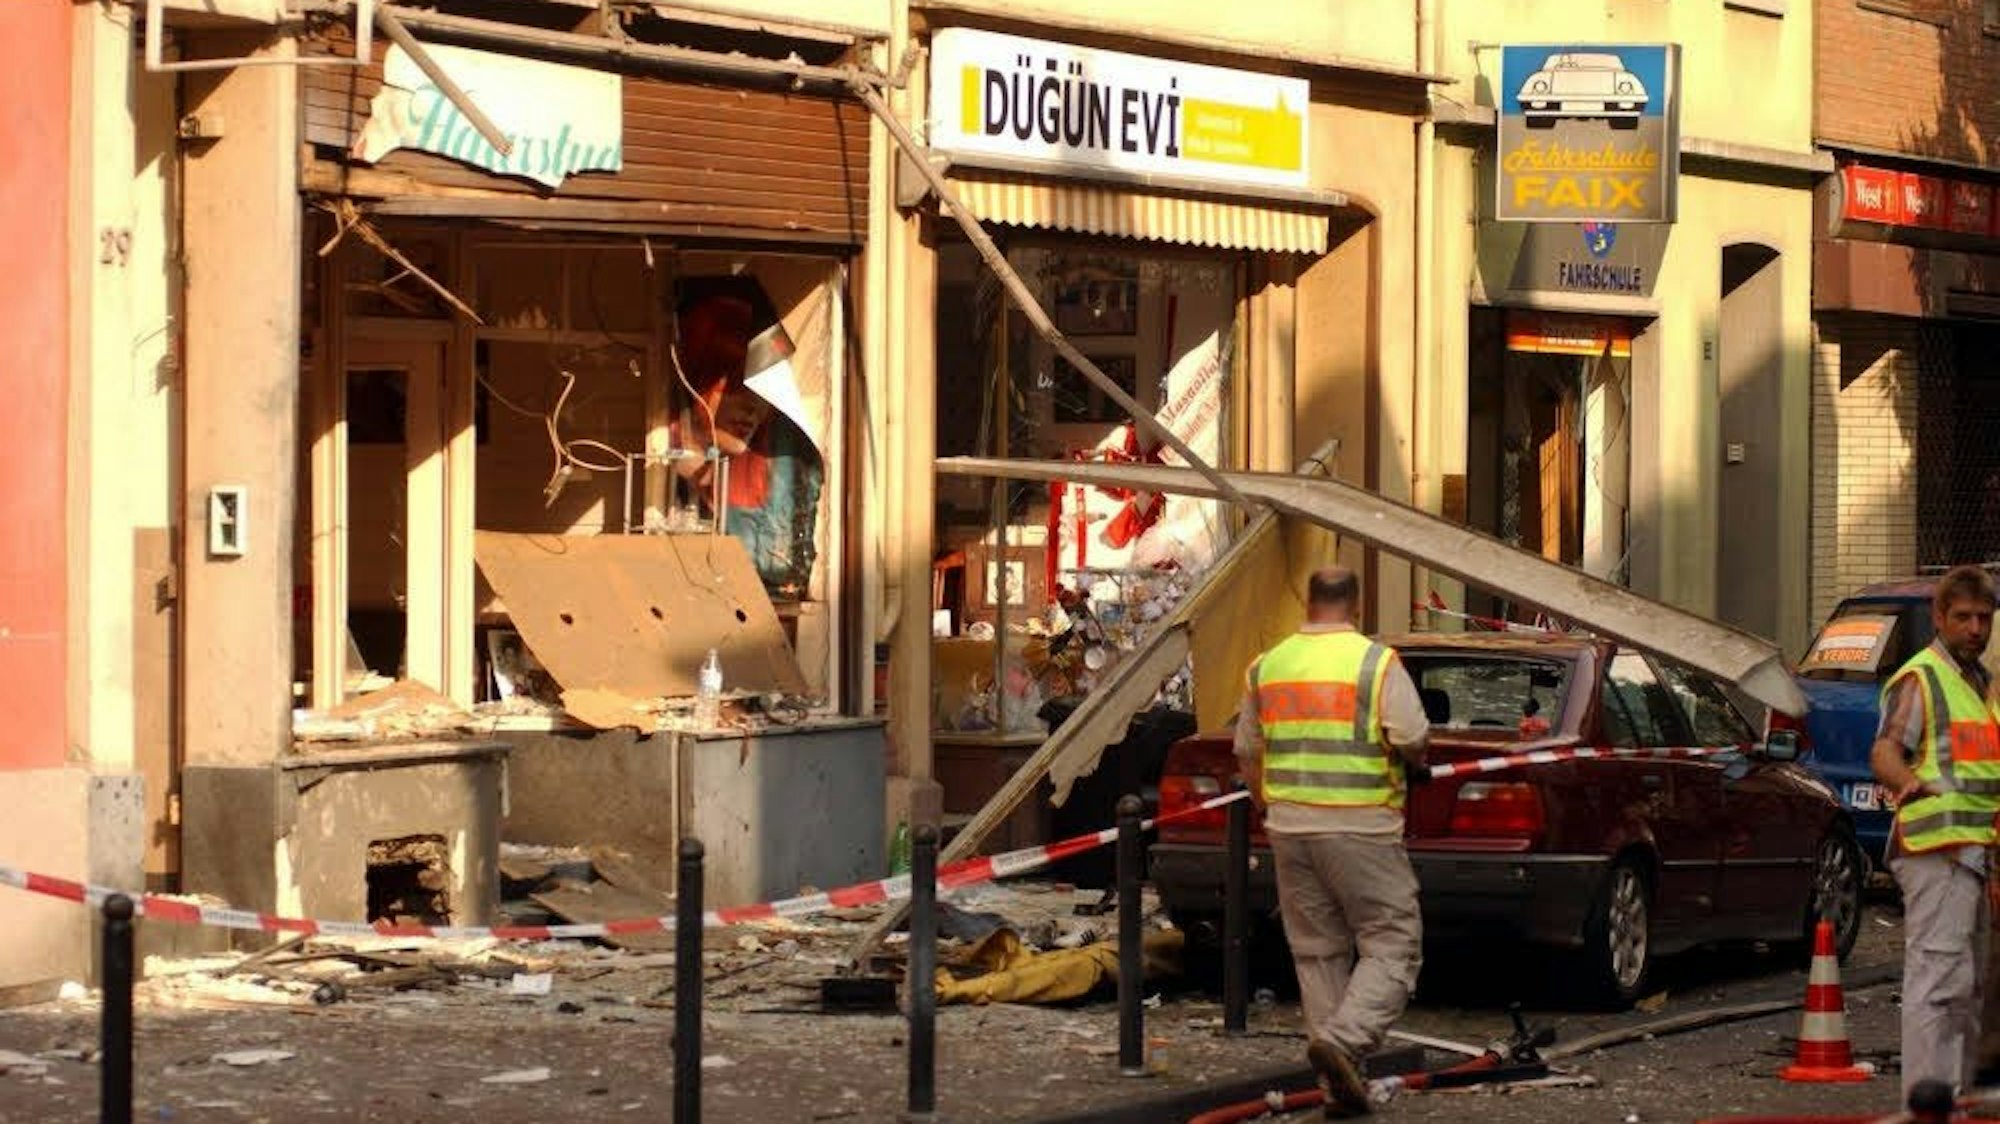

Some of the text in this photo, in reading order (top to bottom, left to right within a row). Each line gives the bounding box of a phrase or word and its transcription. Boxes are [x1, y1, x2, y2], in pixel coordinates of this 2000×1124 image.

[985, 54, 1180, 158] DÜĞÜN EVİ
[1503, 137, 1658, 173] Fahrschule
[1514, 176, 1645, 210] FAIX
[1854, 177, 1882, 209] West
[100, 226, 132, 268] 29
[1559, 262, 1641, 291] FAHRSCHULE
